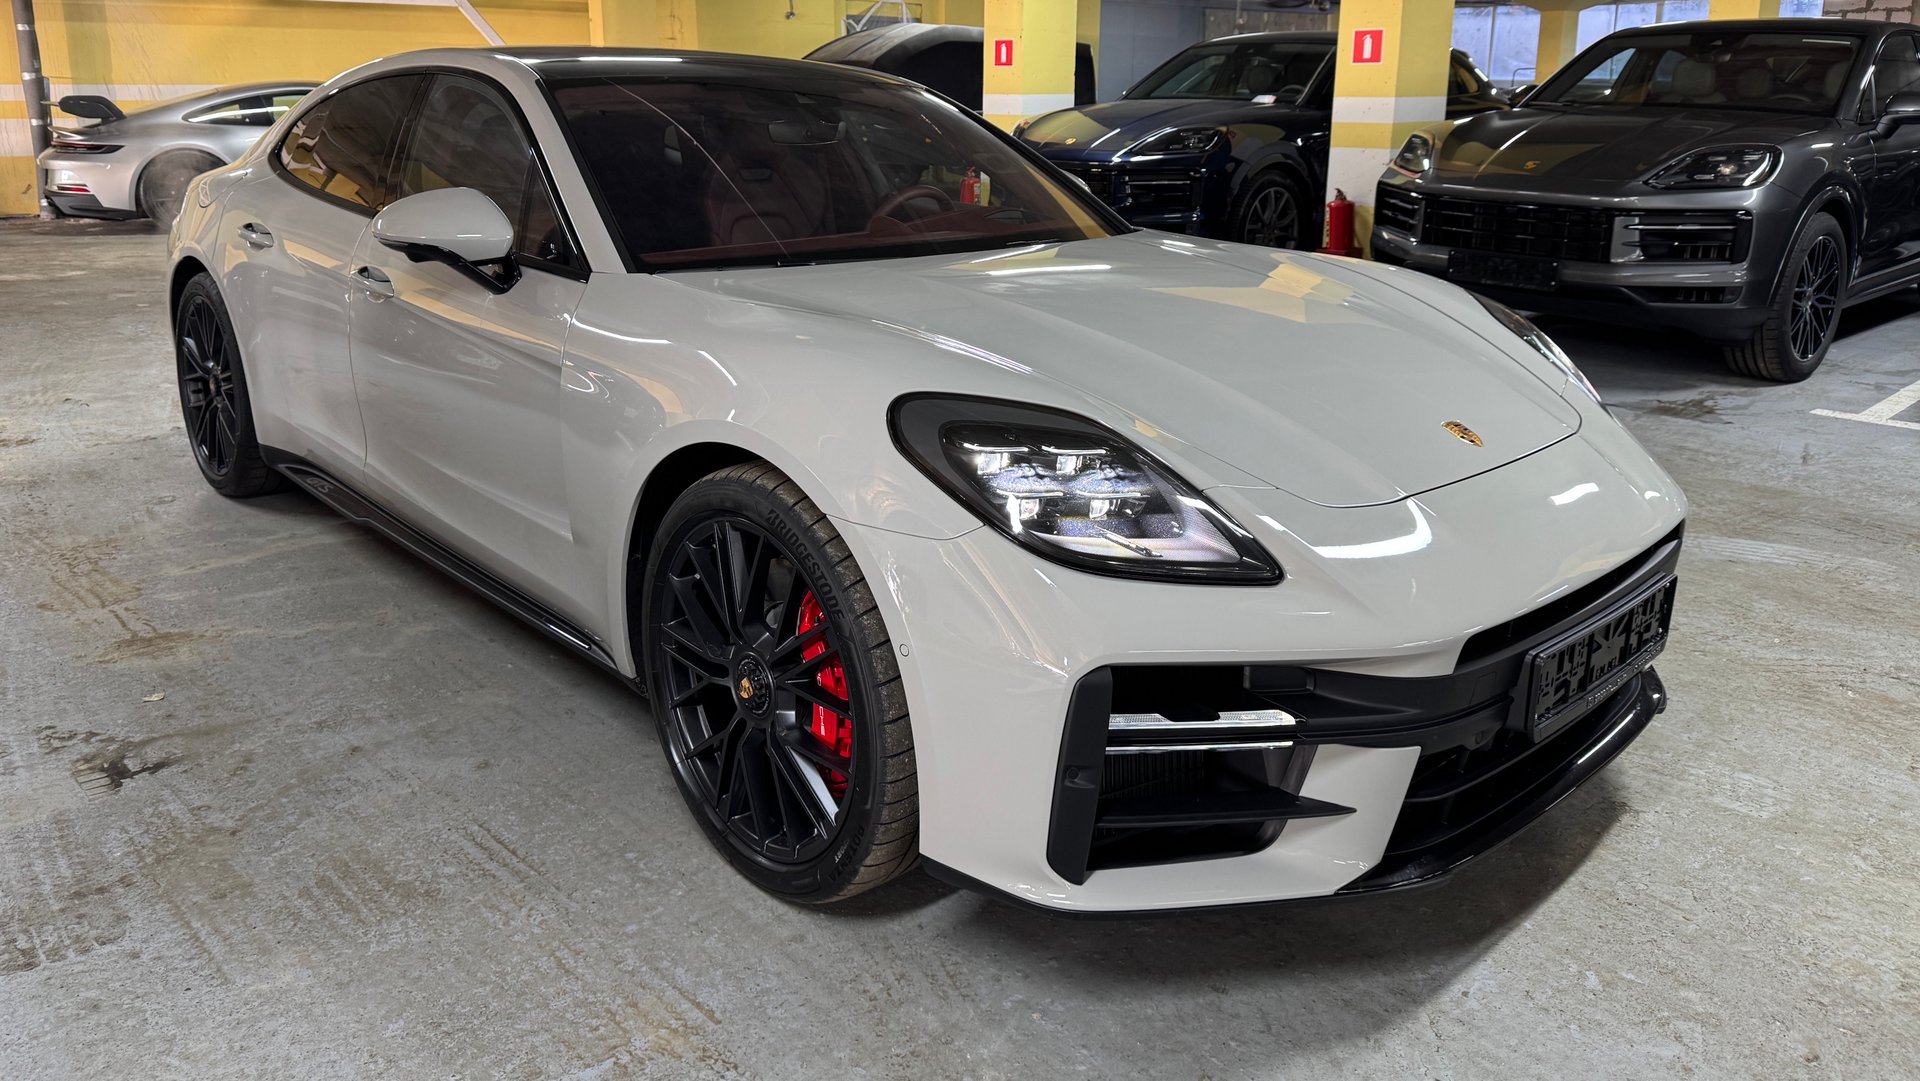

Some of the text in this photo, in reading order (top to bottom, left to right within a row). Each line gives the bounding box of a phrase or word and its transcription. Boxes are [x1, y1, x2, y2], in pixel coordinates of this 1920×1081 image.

[306, 477, 334, 493] GTS
[767, 508, 845, 620] BRIDGESTONE
[828, 825, 865, 880] POTENZA
